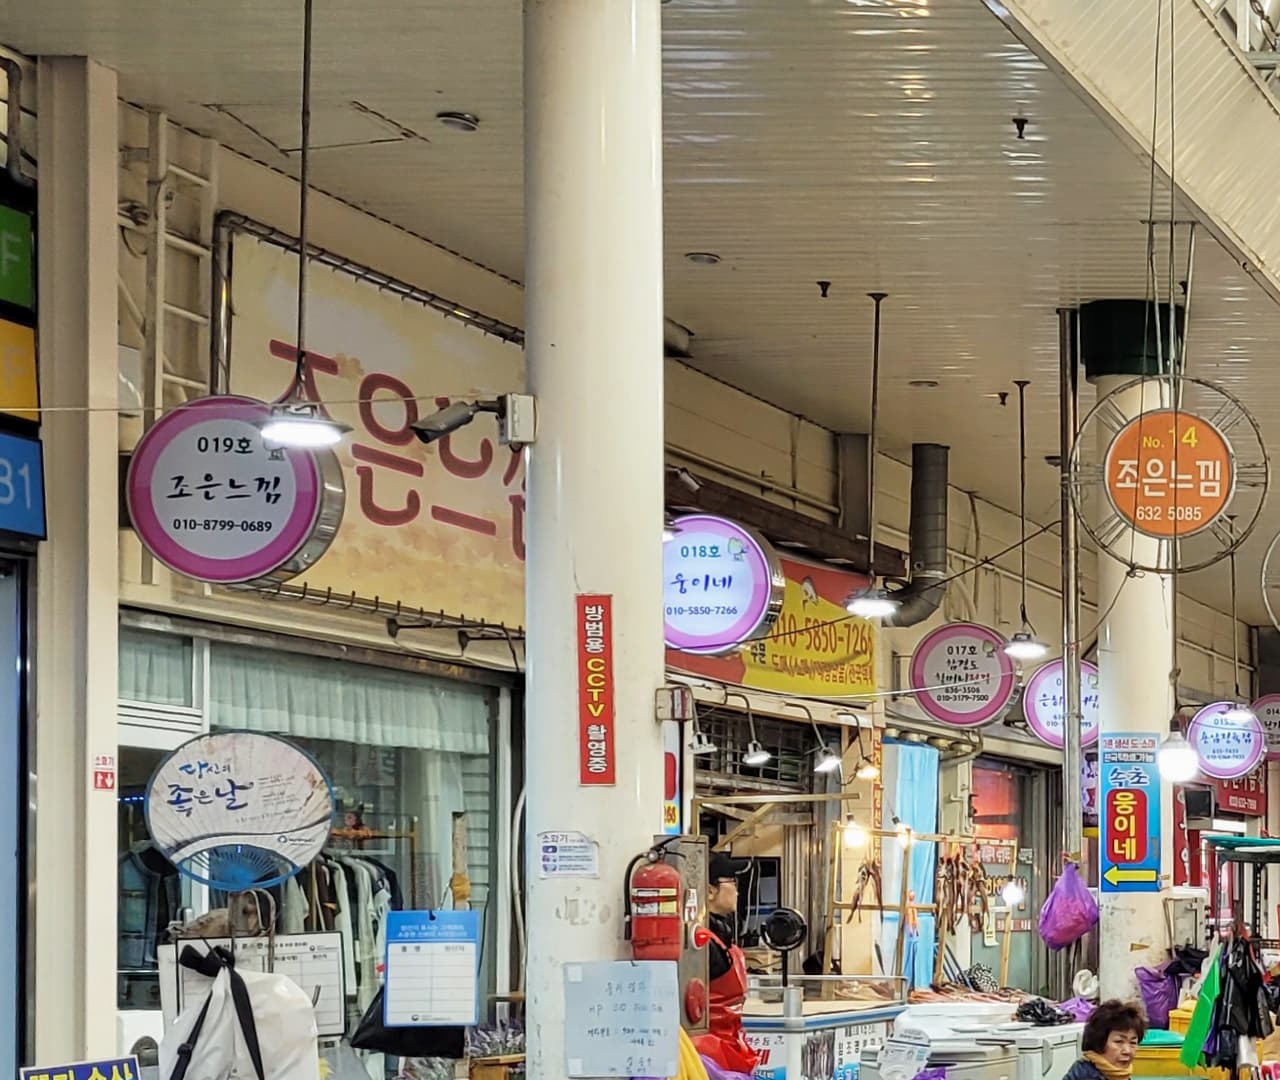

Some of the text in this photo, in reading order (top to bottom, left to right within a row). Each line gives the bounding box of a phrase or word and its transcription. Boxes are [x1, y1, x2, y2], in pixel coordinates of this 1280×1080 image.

[196, 435, 255, 455] 019호
[1168, 426, 1198, 448] 14
[1116, 458, 1222, 498] 조은느낌
[166, 475, 282, 504] 조은느낌
[1136, 506, 1202, 521] 632 5085
[172, 518, 273, 533] 010-8799-0689
[680, 544, 721, 558] 018호
[665, 605, 739, 615] 010-5850-7266
[946, 644, 978, 656] 017호
[586, 657, 606, 717] CCTV
[1109, 767, 1149, 788] 속초
[541, 832, 569, 846] 소화기
